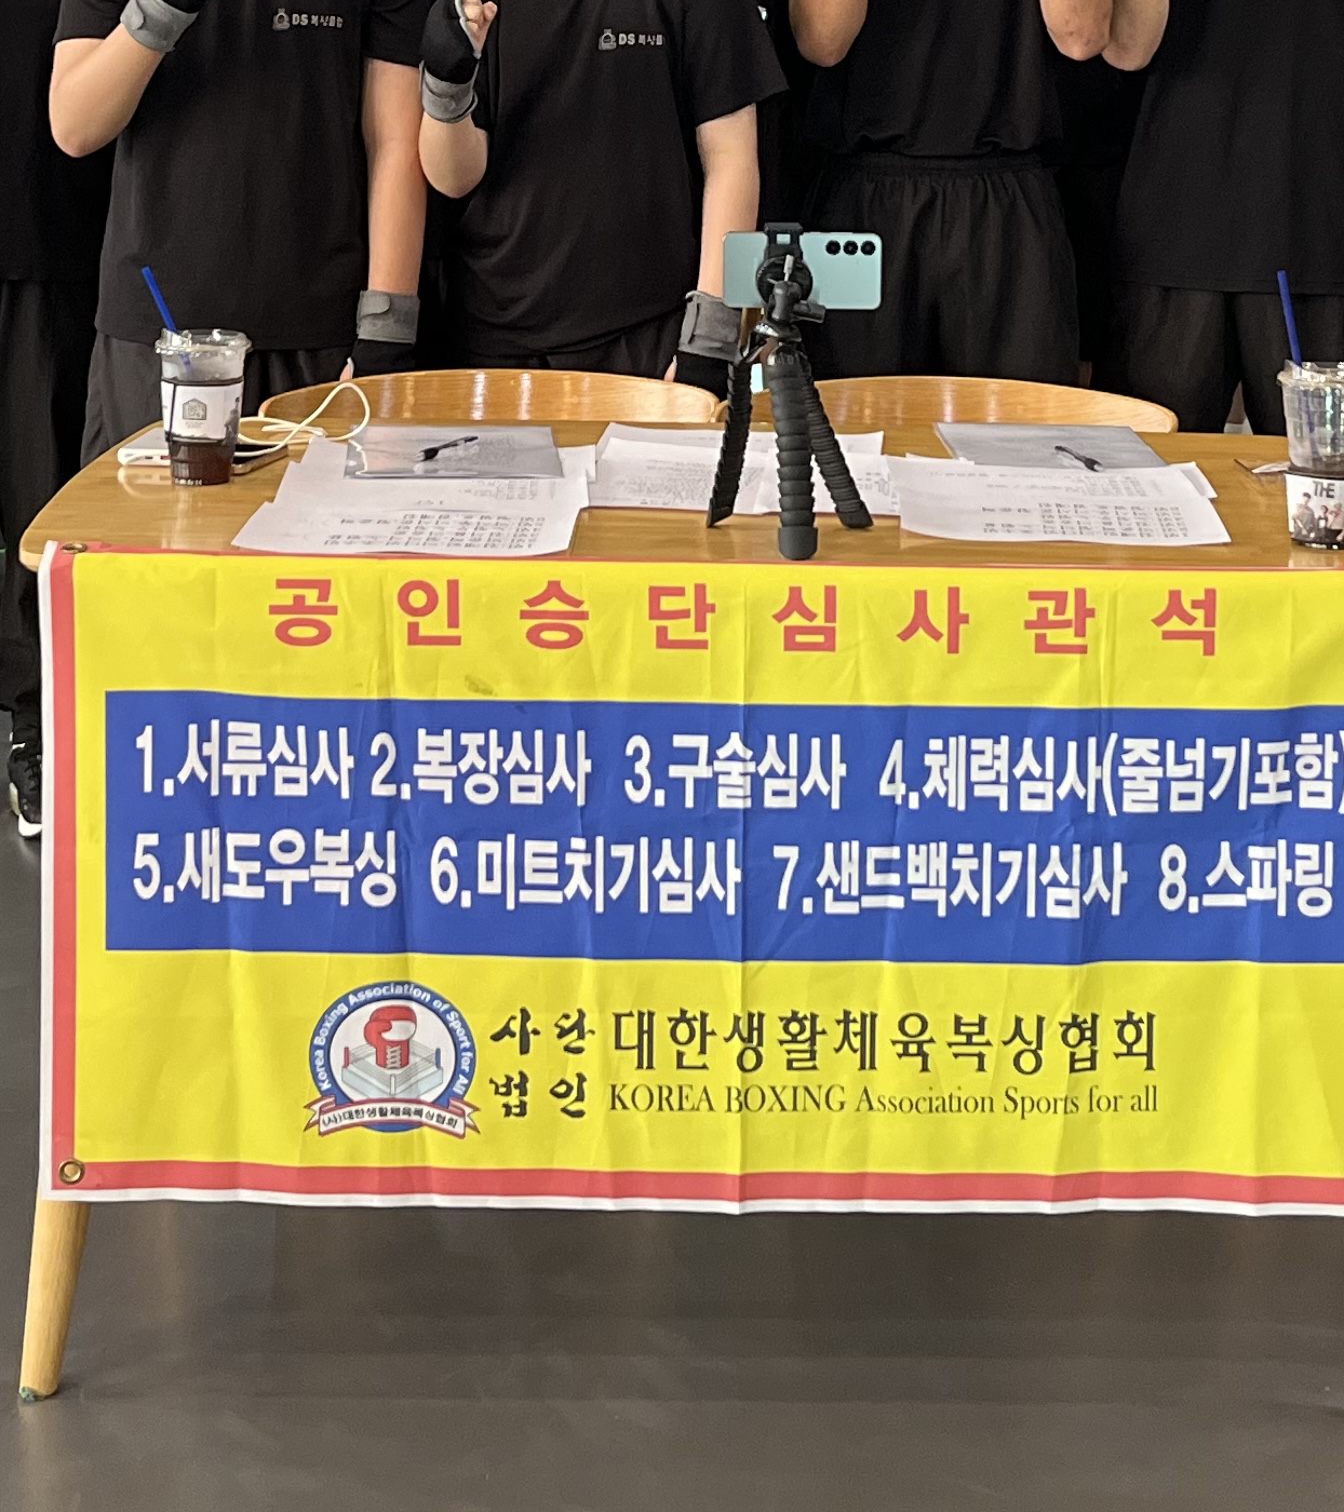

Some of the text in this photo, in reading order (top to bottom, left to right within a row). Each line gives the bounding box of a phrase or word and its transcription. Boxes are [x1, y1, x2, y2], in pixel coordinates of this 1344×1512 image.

[291, 13, 309, 26] DS
[618, 32, 636, 46] DS
[135, 718, 355, 799] 1.서류심사
[369, 728, 593, 807] 2.복장심사
[624, 731, 847, 810] 3.구술심사
[430, 833, 741, 915] 6.미트치기심사
[1158, 841, 1335, 917] 8.스파링
[347, 983, 431, 1006] Association
[432, 998, 451, 1013] of
[313, 1002, 349, 1046] Boxing
[445, 1010, 472, 1050] Sport
[611, 1007, 1157, 1075] 대한생활체육복싱협회
[313, 1049, 333, 1091] Korea
[460, 1050, 474, 1074] for
[608, 1082, 1158, 1121] KOREA BOXING Association Sports for all
